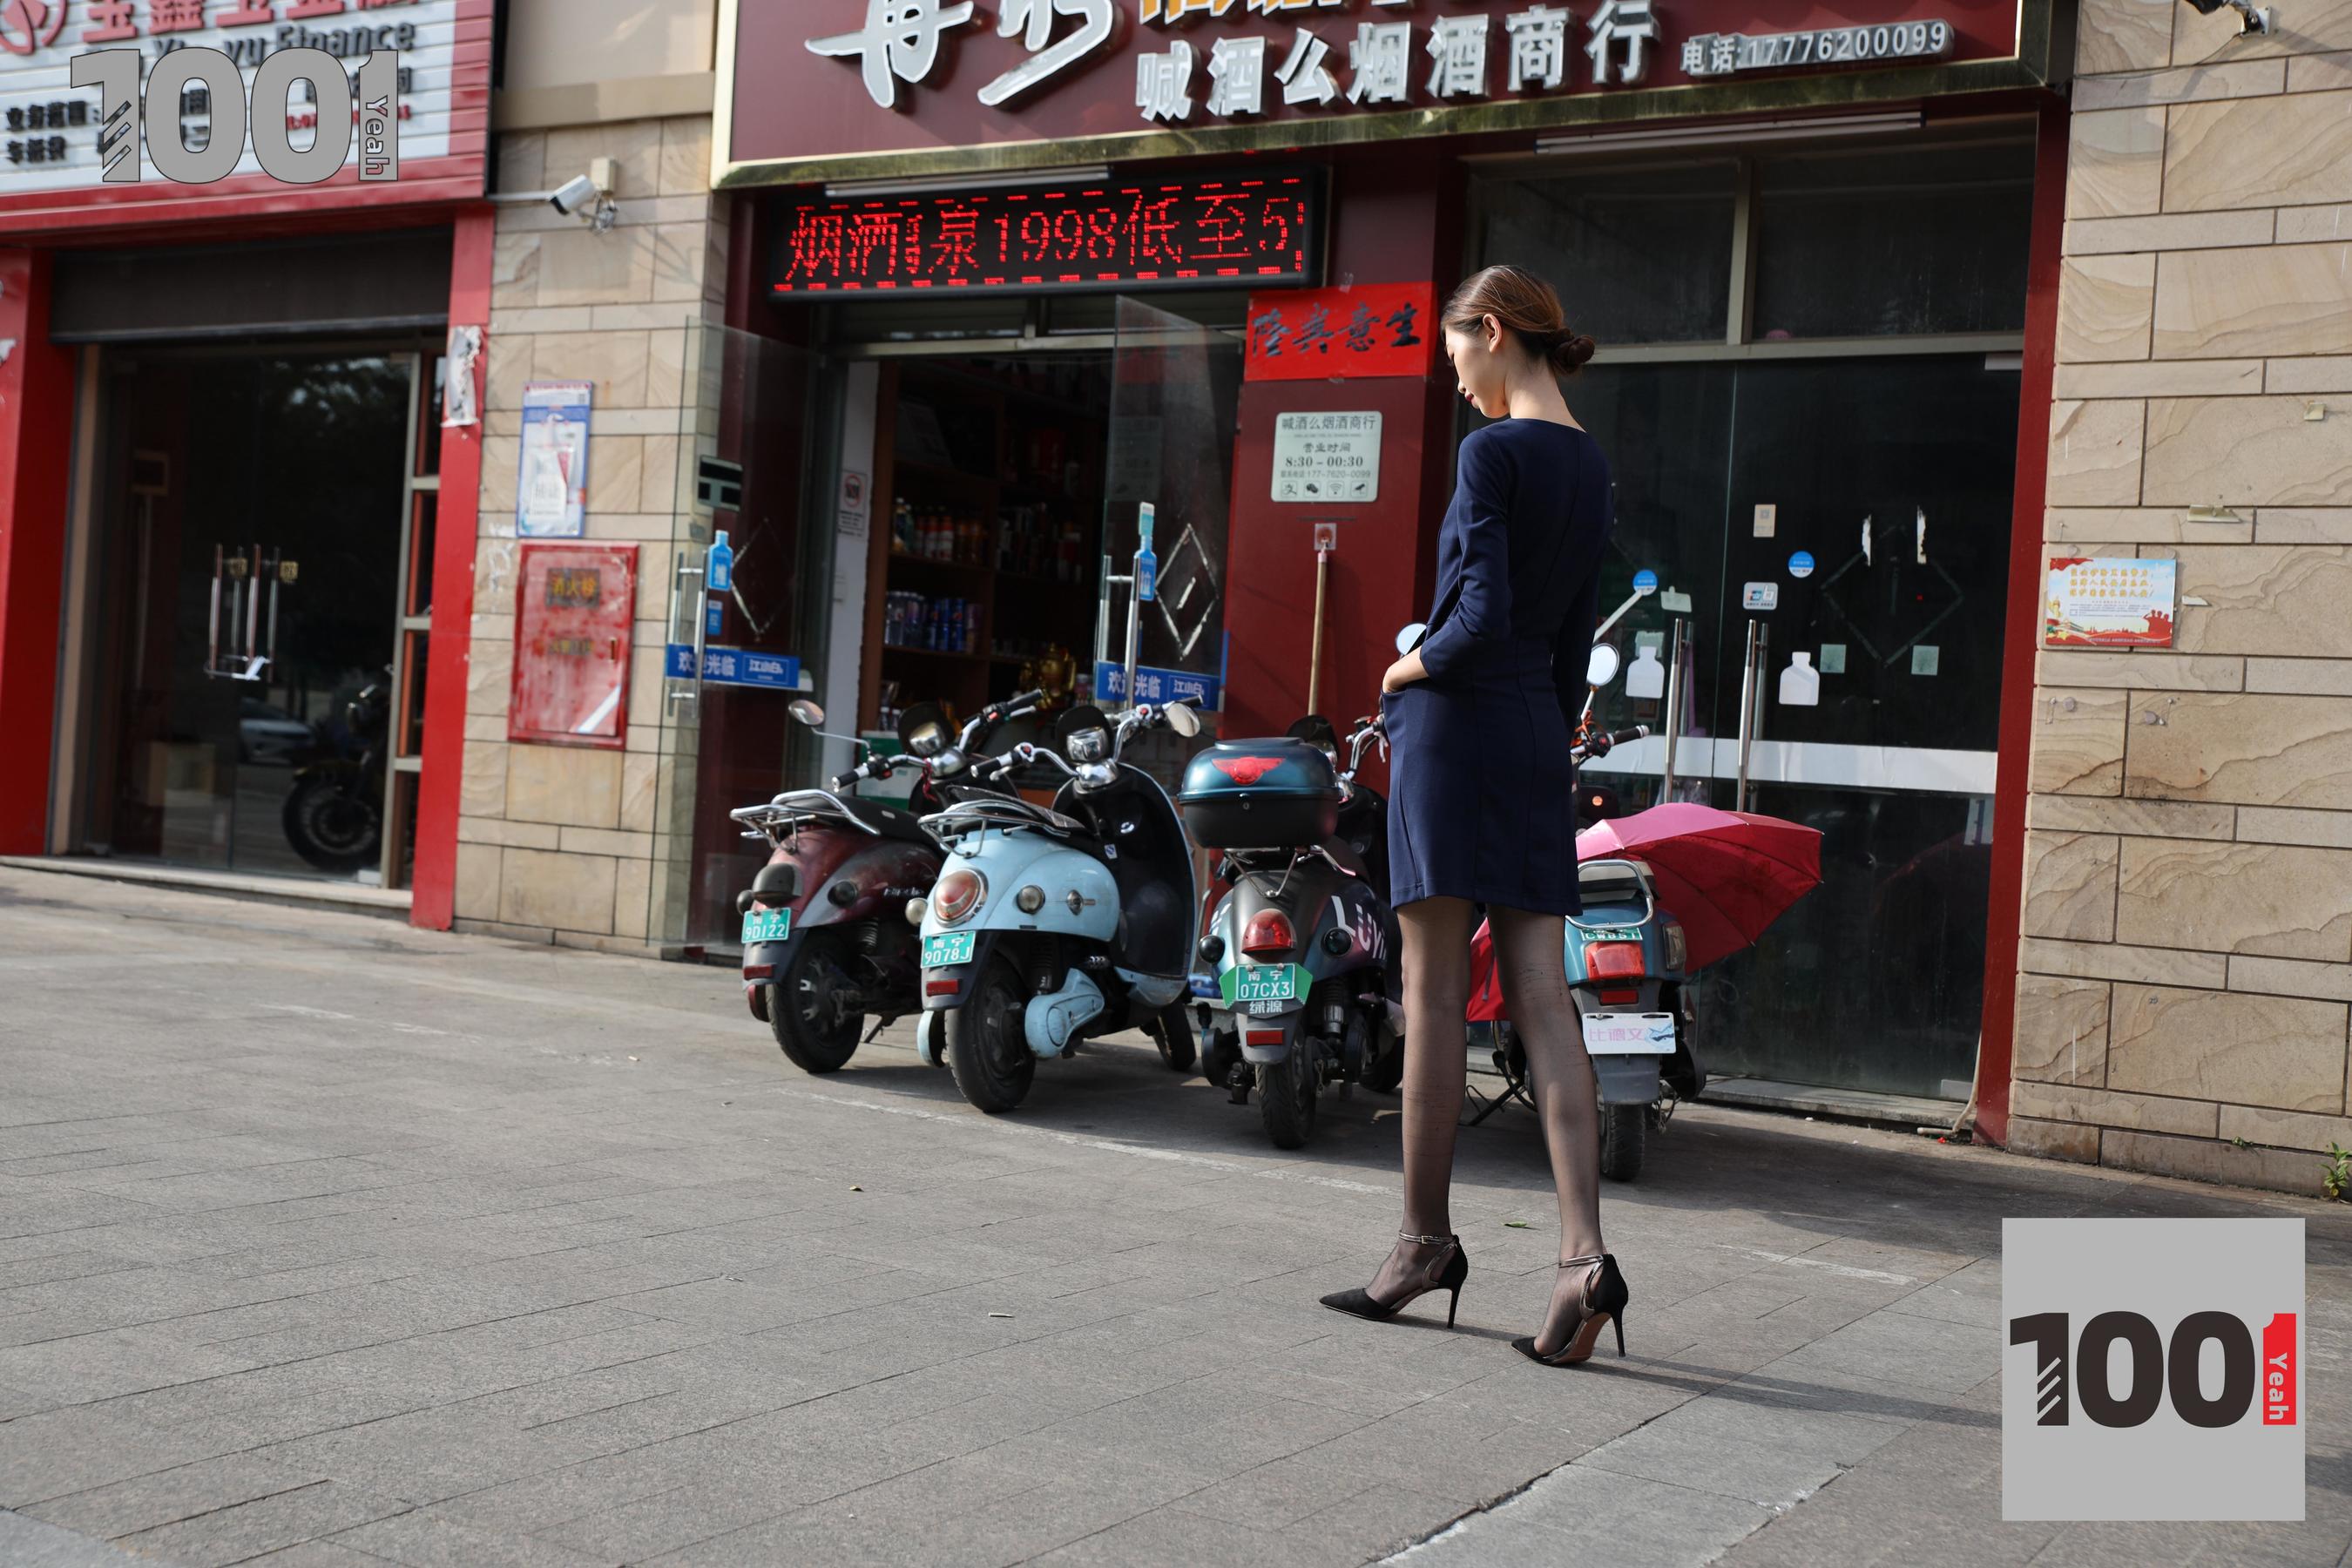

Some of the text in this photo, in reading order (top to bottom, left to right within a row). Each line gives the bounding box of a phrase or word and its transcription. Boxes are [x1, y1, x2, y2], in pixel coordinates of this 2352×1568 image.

[1136, 0, 1655, 121] 喊酒么烟酒商行
[1281, 415, 1376, 431] 喊酒么烟酒商行
[1302, 442, 1351, 454] 营业时间
[745, 923, 786, 940] 90122
[924, 946, 970, 965] 9078J
[1247, 970, 1283, 982] 南宁
[1240, 981, 1290, 998] 07CX3
[1249, 1000, 1283, 1015] 绿源
